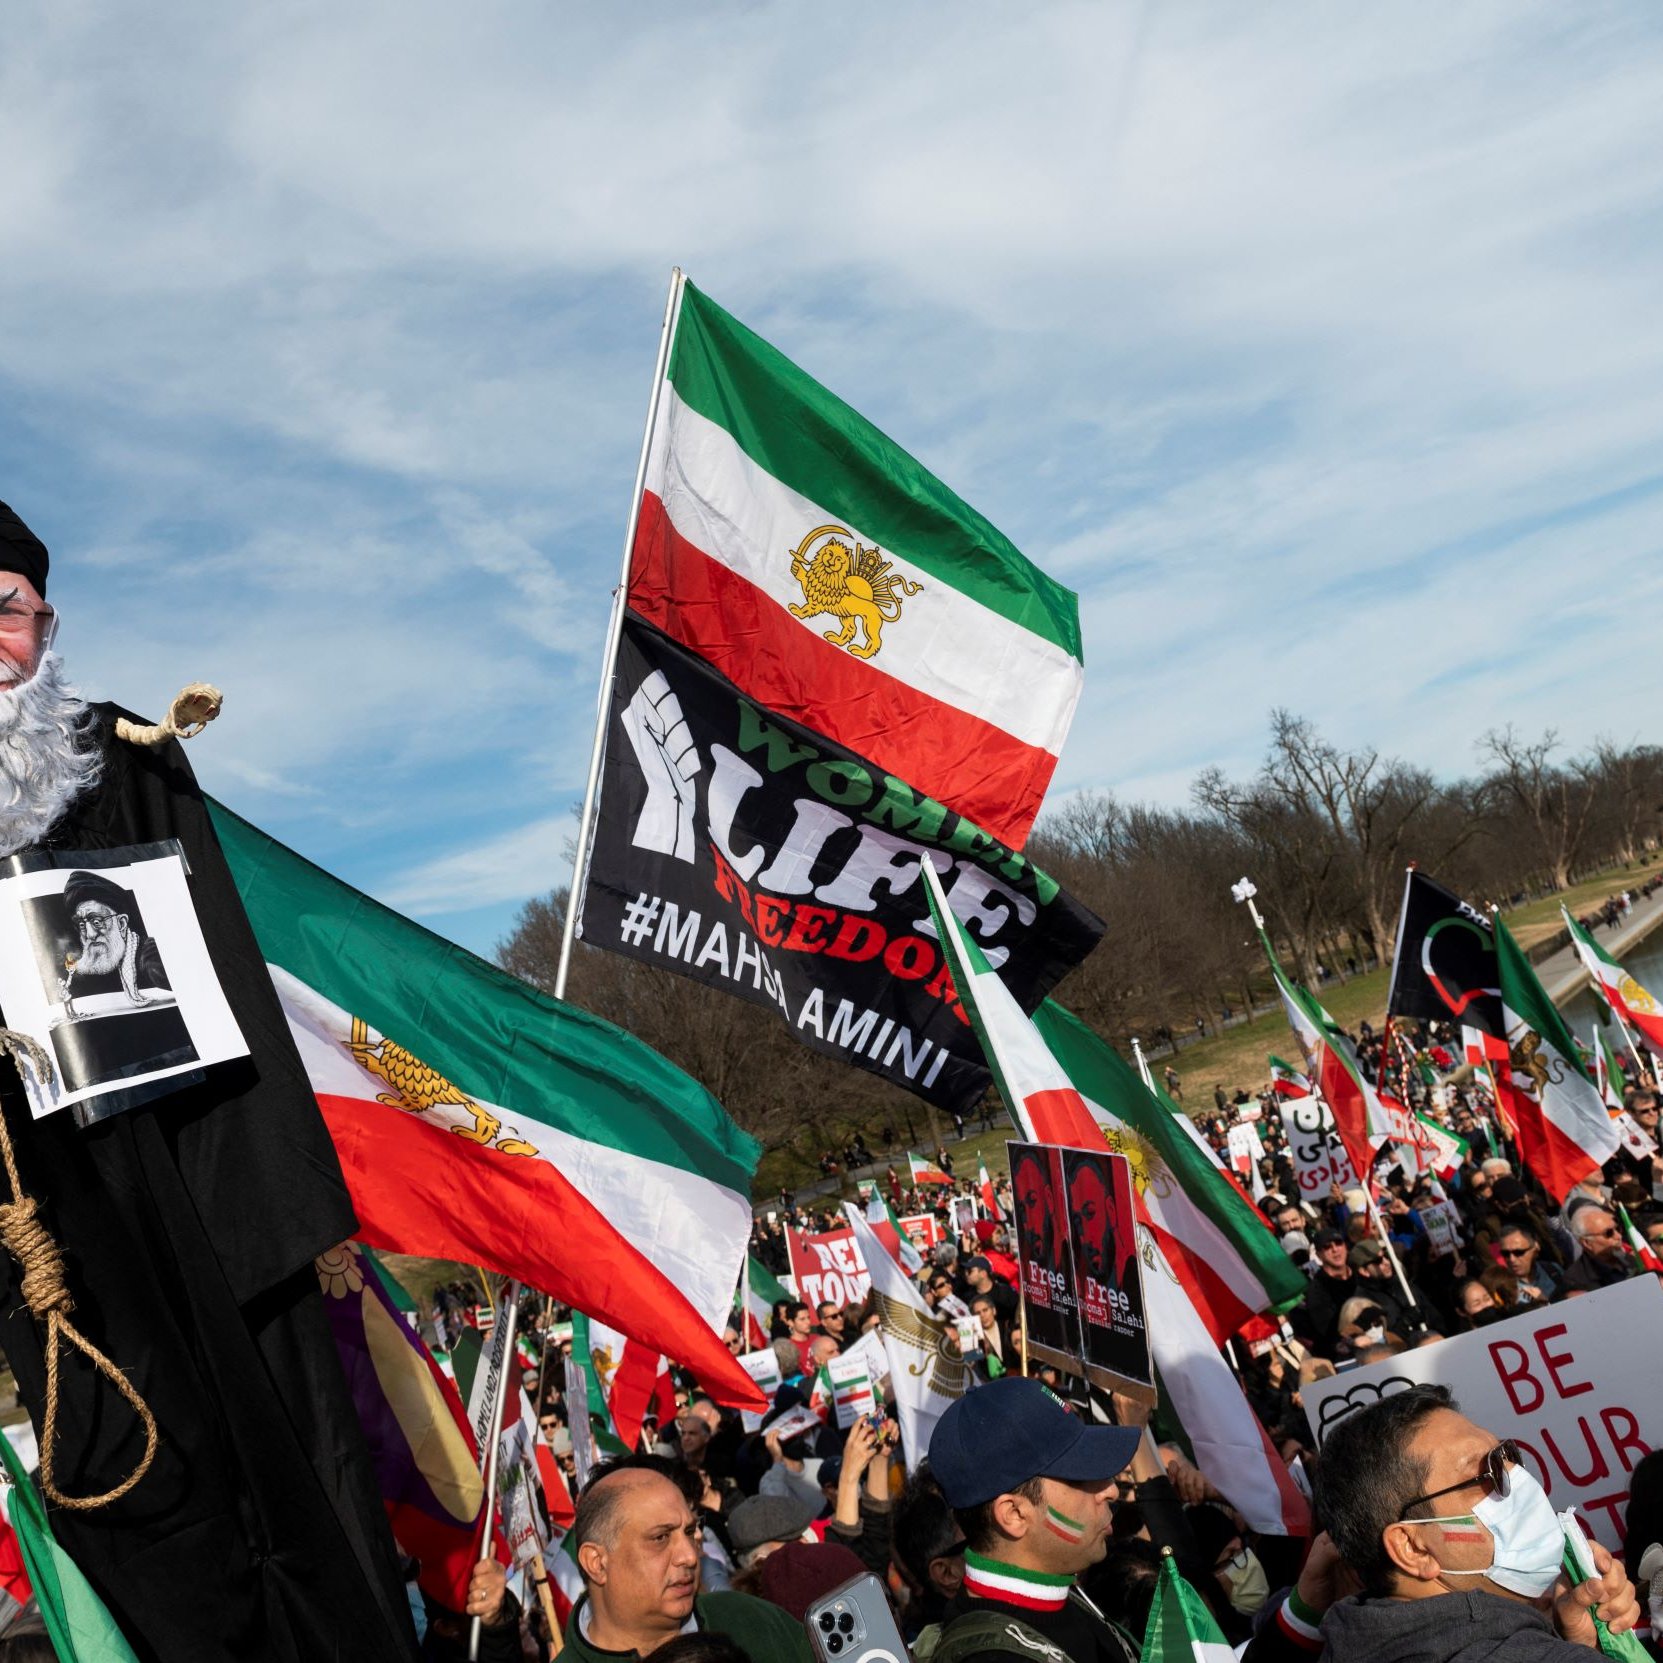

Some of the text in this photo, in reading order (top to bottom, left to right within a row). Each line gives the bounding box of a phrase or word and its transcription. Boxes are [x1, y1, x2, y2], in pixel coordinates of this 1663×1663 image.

[708, 742, 1037, 971] LIFE
[620, 891, 950, 1089] #MAHSA AMINI
[1029, 1260, 1066, 1292] Free
[1086, 1276, 1130, 1312] Free
[1051, 1289, 1078, 1308] Salehi
[1111, 1310, 1145, 1330] Salehi
[1488, 1322, 1595, 1416] BE
